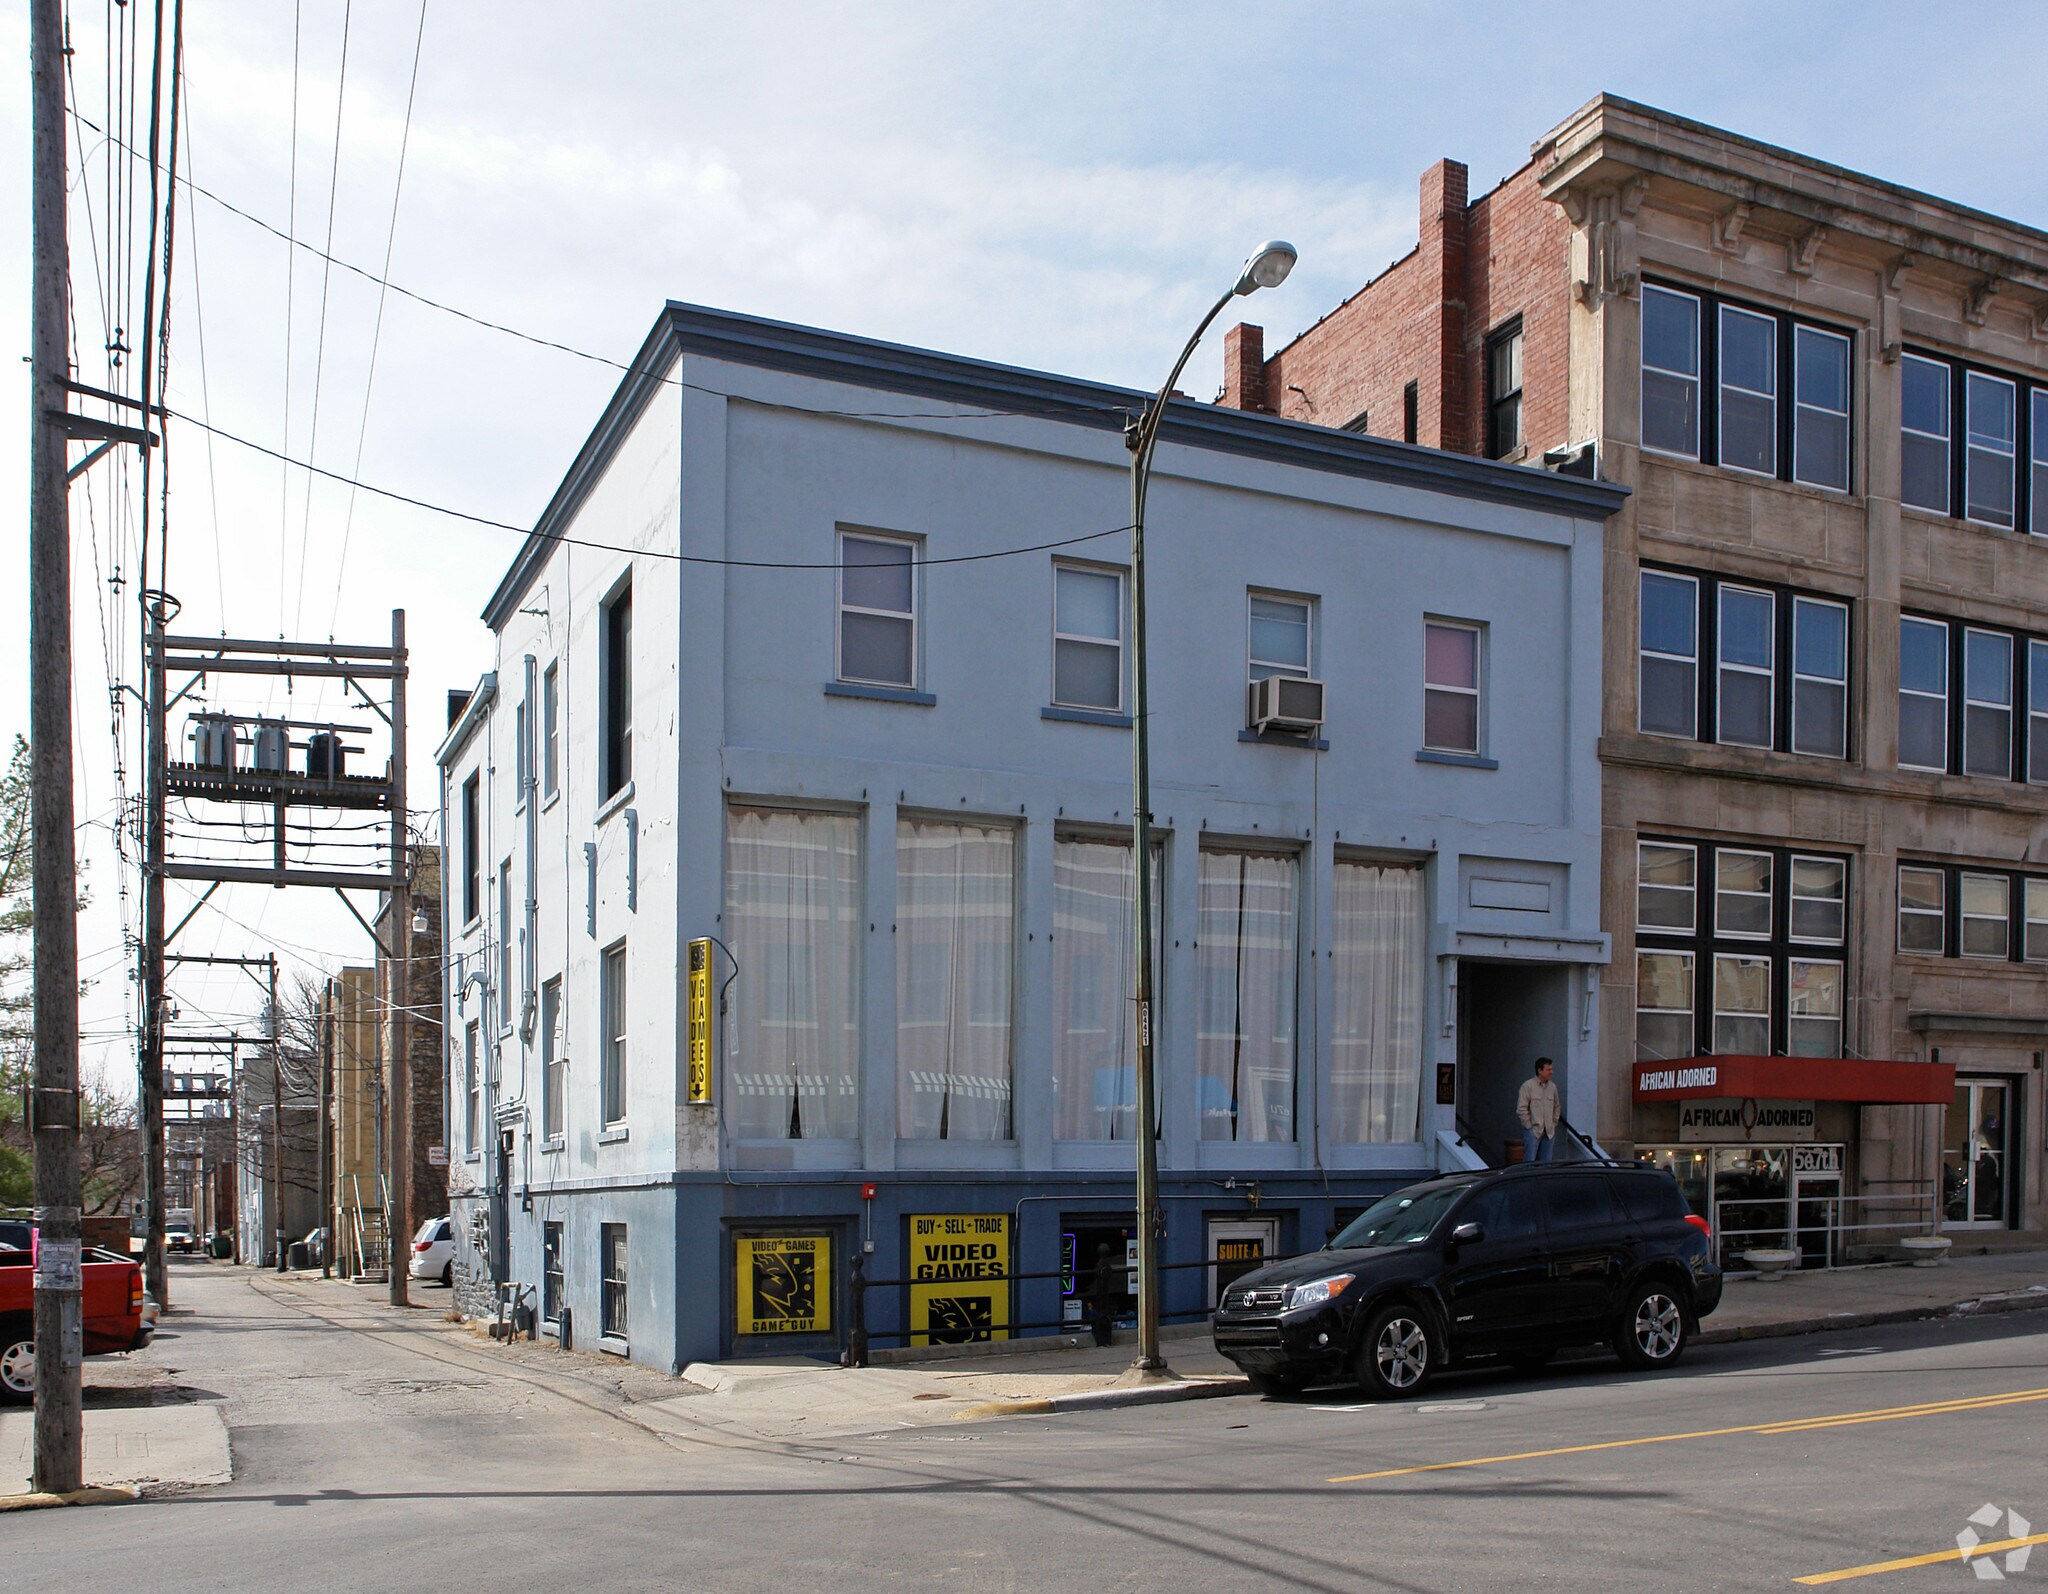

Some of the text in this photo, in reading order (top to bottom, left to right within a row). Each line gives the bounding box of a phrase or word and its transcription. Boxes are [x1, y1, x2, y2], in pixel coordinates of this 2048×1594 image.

[698, 978, 706, 1083] GAMES
[1640, 1066, 1717, 1091] AFRICAN ADORNED
[1682, 1108, 1813, 1127] AFRICAN ADORNED
[917, 1218, 1002, 1234] BUY SELL TRADE
[752, 1240, 816, 1252] VIDEO GAMES
[924, 1243, 997, 1261] VIDEO
[1219, 1243, 1260, 1259] SUITE A
[917, 1262, 1004, 1280] GAMES
[752, 1319, 815, 1332] GAME GUY
